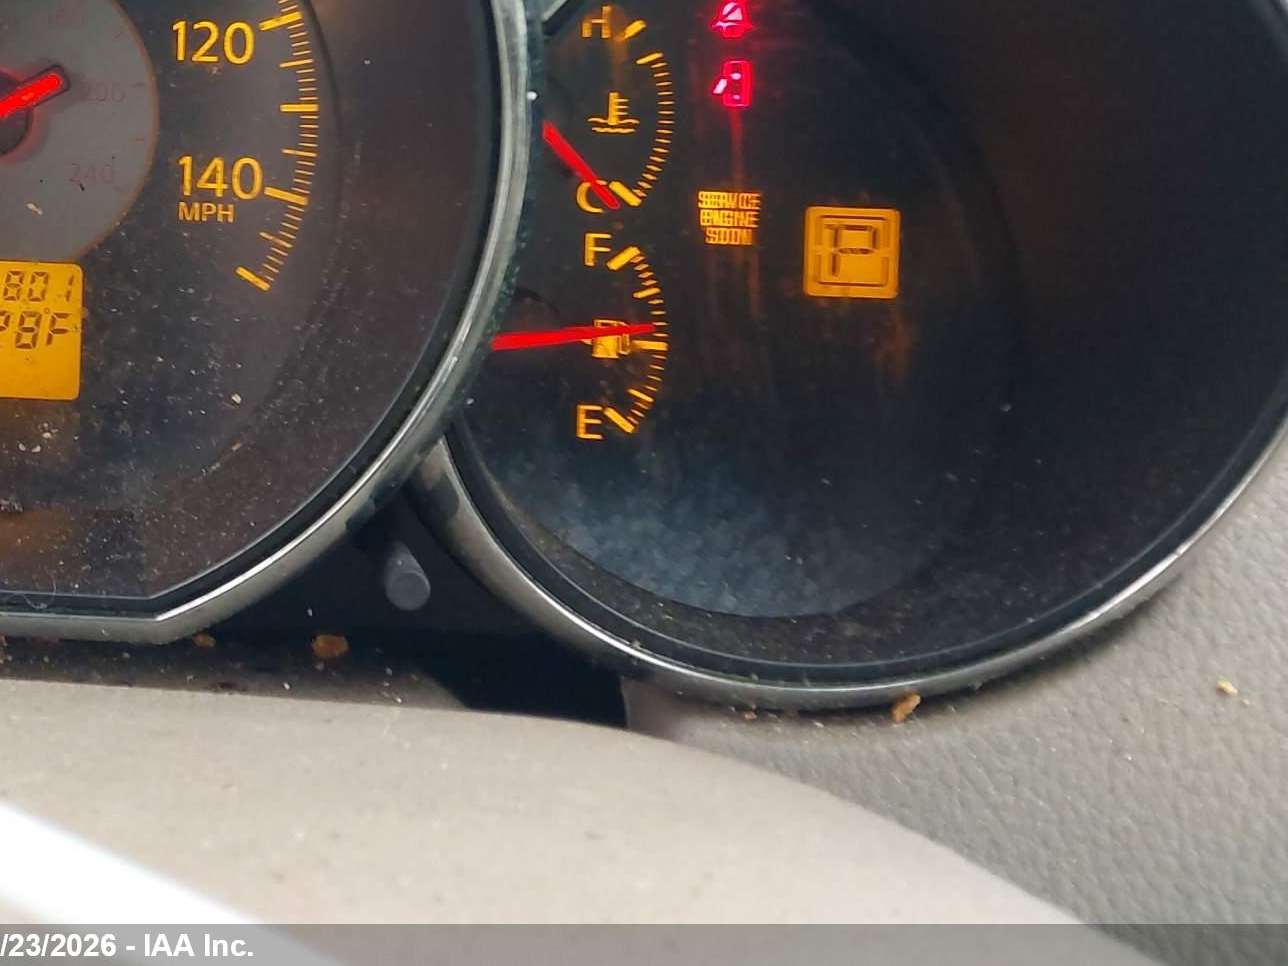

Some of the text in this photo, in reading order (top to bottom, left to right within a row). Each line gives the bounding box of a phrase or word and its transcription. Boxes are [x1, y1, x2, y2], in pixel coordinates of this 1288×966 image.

[582, 5, 612, 39] H
[172, 20, 255, 65] 120
[178, 155, 264, 201] 140
[178, 201, 235, 224] MPH
[697, 190, 761, 210] SERVICE
[699, 209, 760, 228] ENGINE
[584, 233, 612, 267] F
[704, 227, 753, 245] SOON
[576, 404, 605, 440] E
